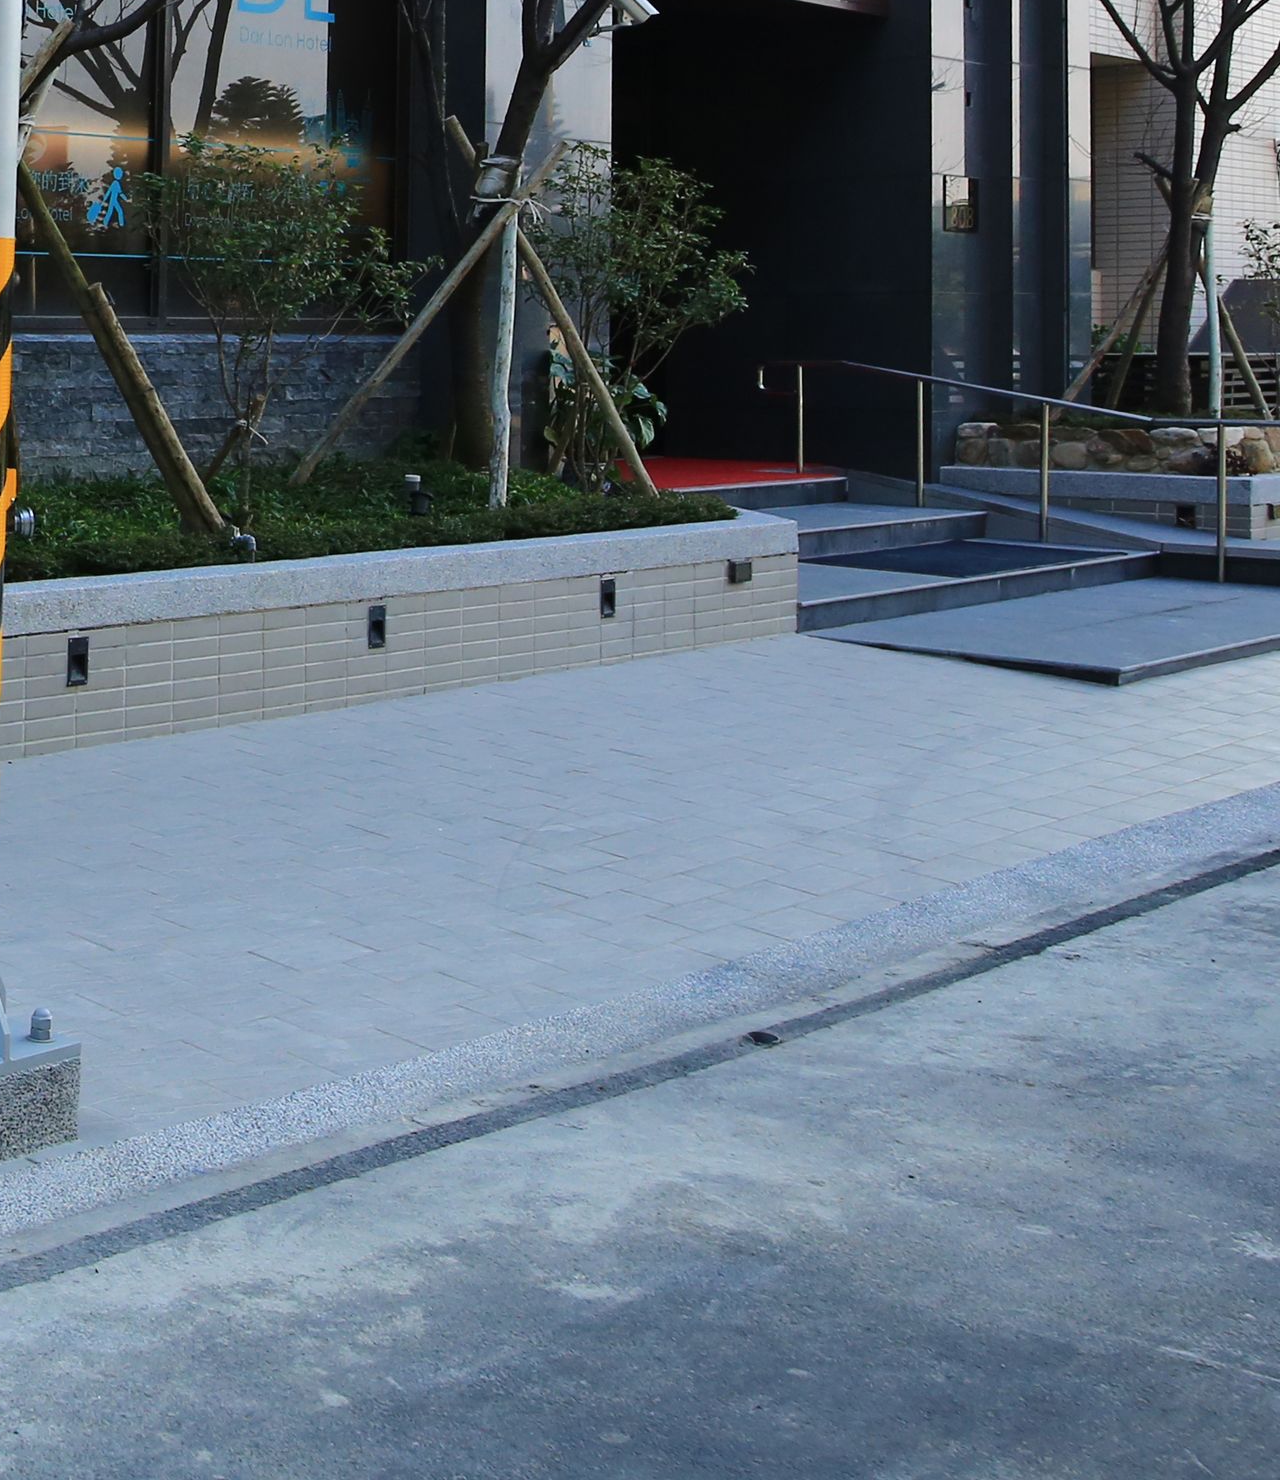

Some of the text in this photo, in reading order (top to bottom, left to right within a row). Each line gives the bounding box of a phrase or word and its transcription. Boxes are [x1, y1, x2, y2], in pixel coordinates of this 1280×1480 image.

[239, 25, 333, 53] Dar Lon Hotel
[49, 206, 73, 222] otel
